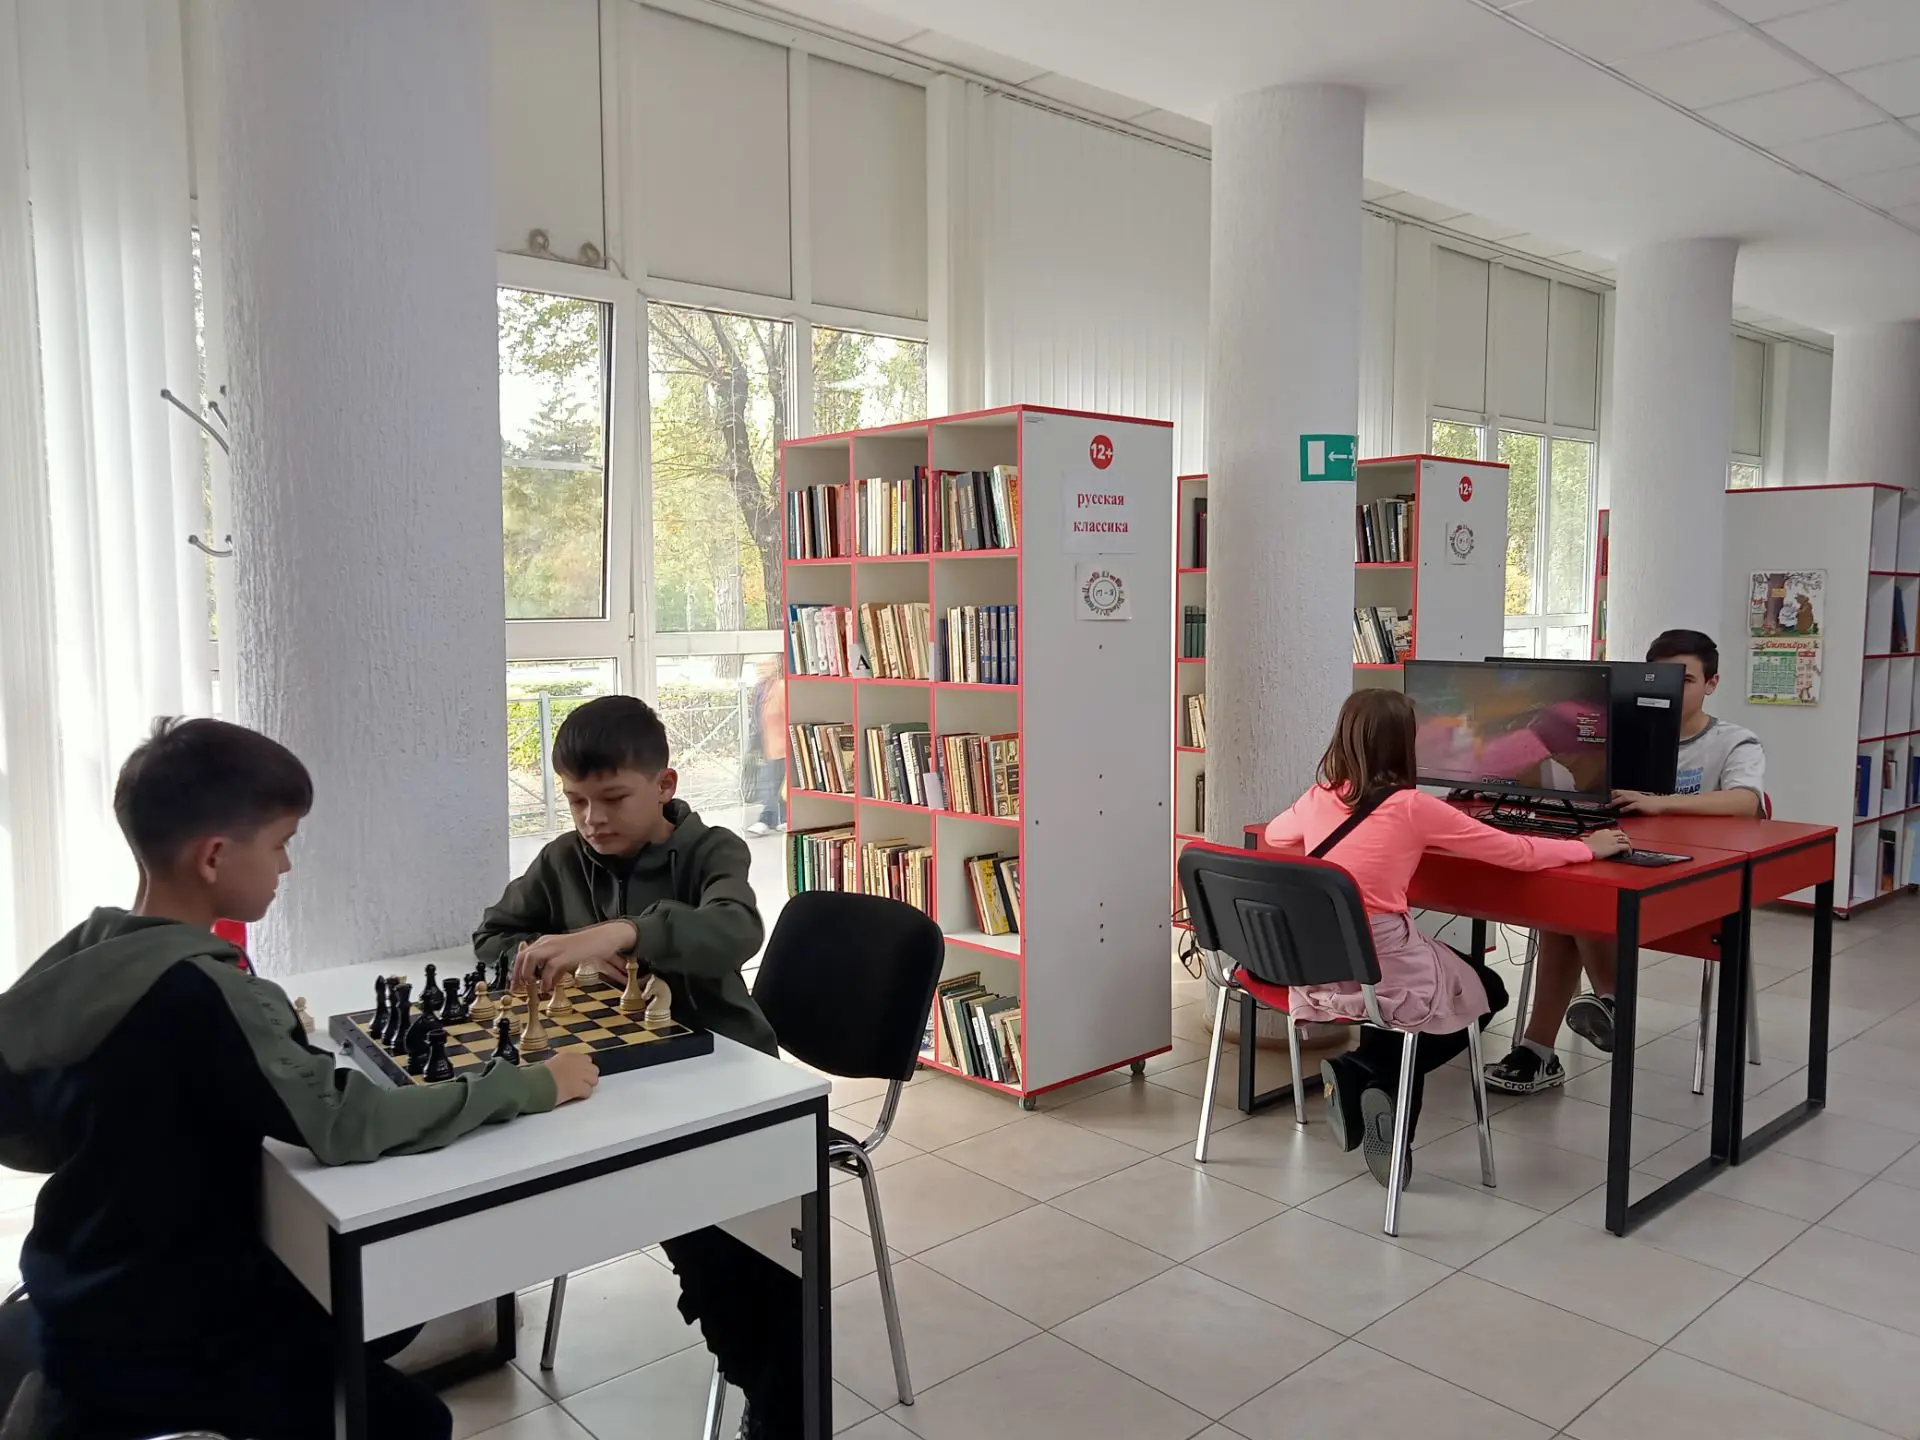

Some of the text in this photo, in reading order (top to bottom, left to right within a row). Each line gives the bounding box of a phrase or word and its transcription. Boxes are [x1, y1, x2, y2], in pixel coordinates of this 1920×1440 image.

[1091, 443, 1113, 460] 12+
[1459, 483, 1473, 495] 12+
[1077, 492, 1125, 508] русская
[1073, 520, 1129, 533] классика
[1504, 1081, 1535, 1091] crocs
